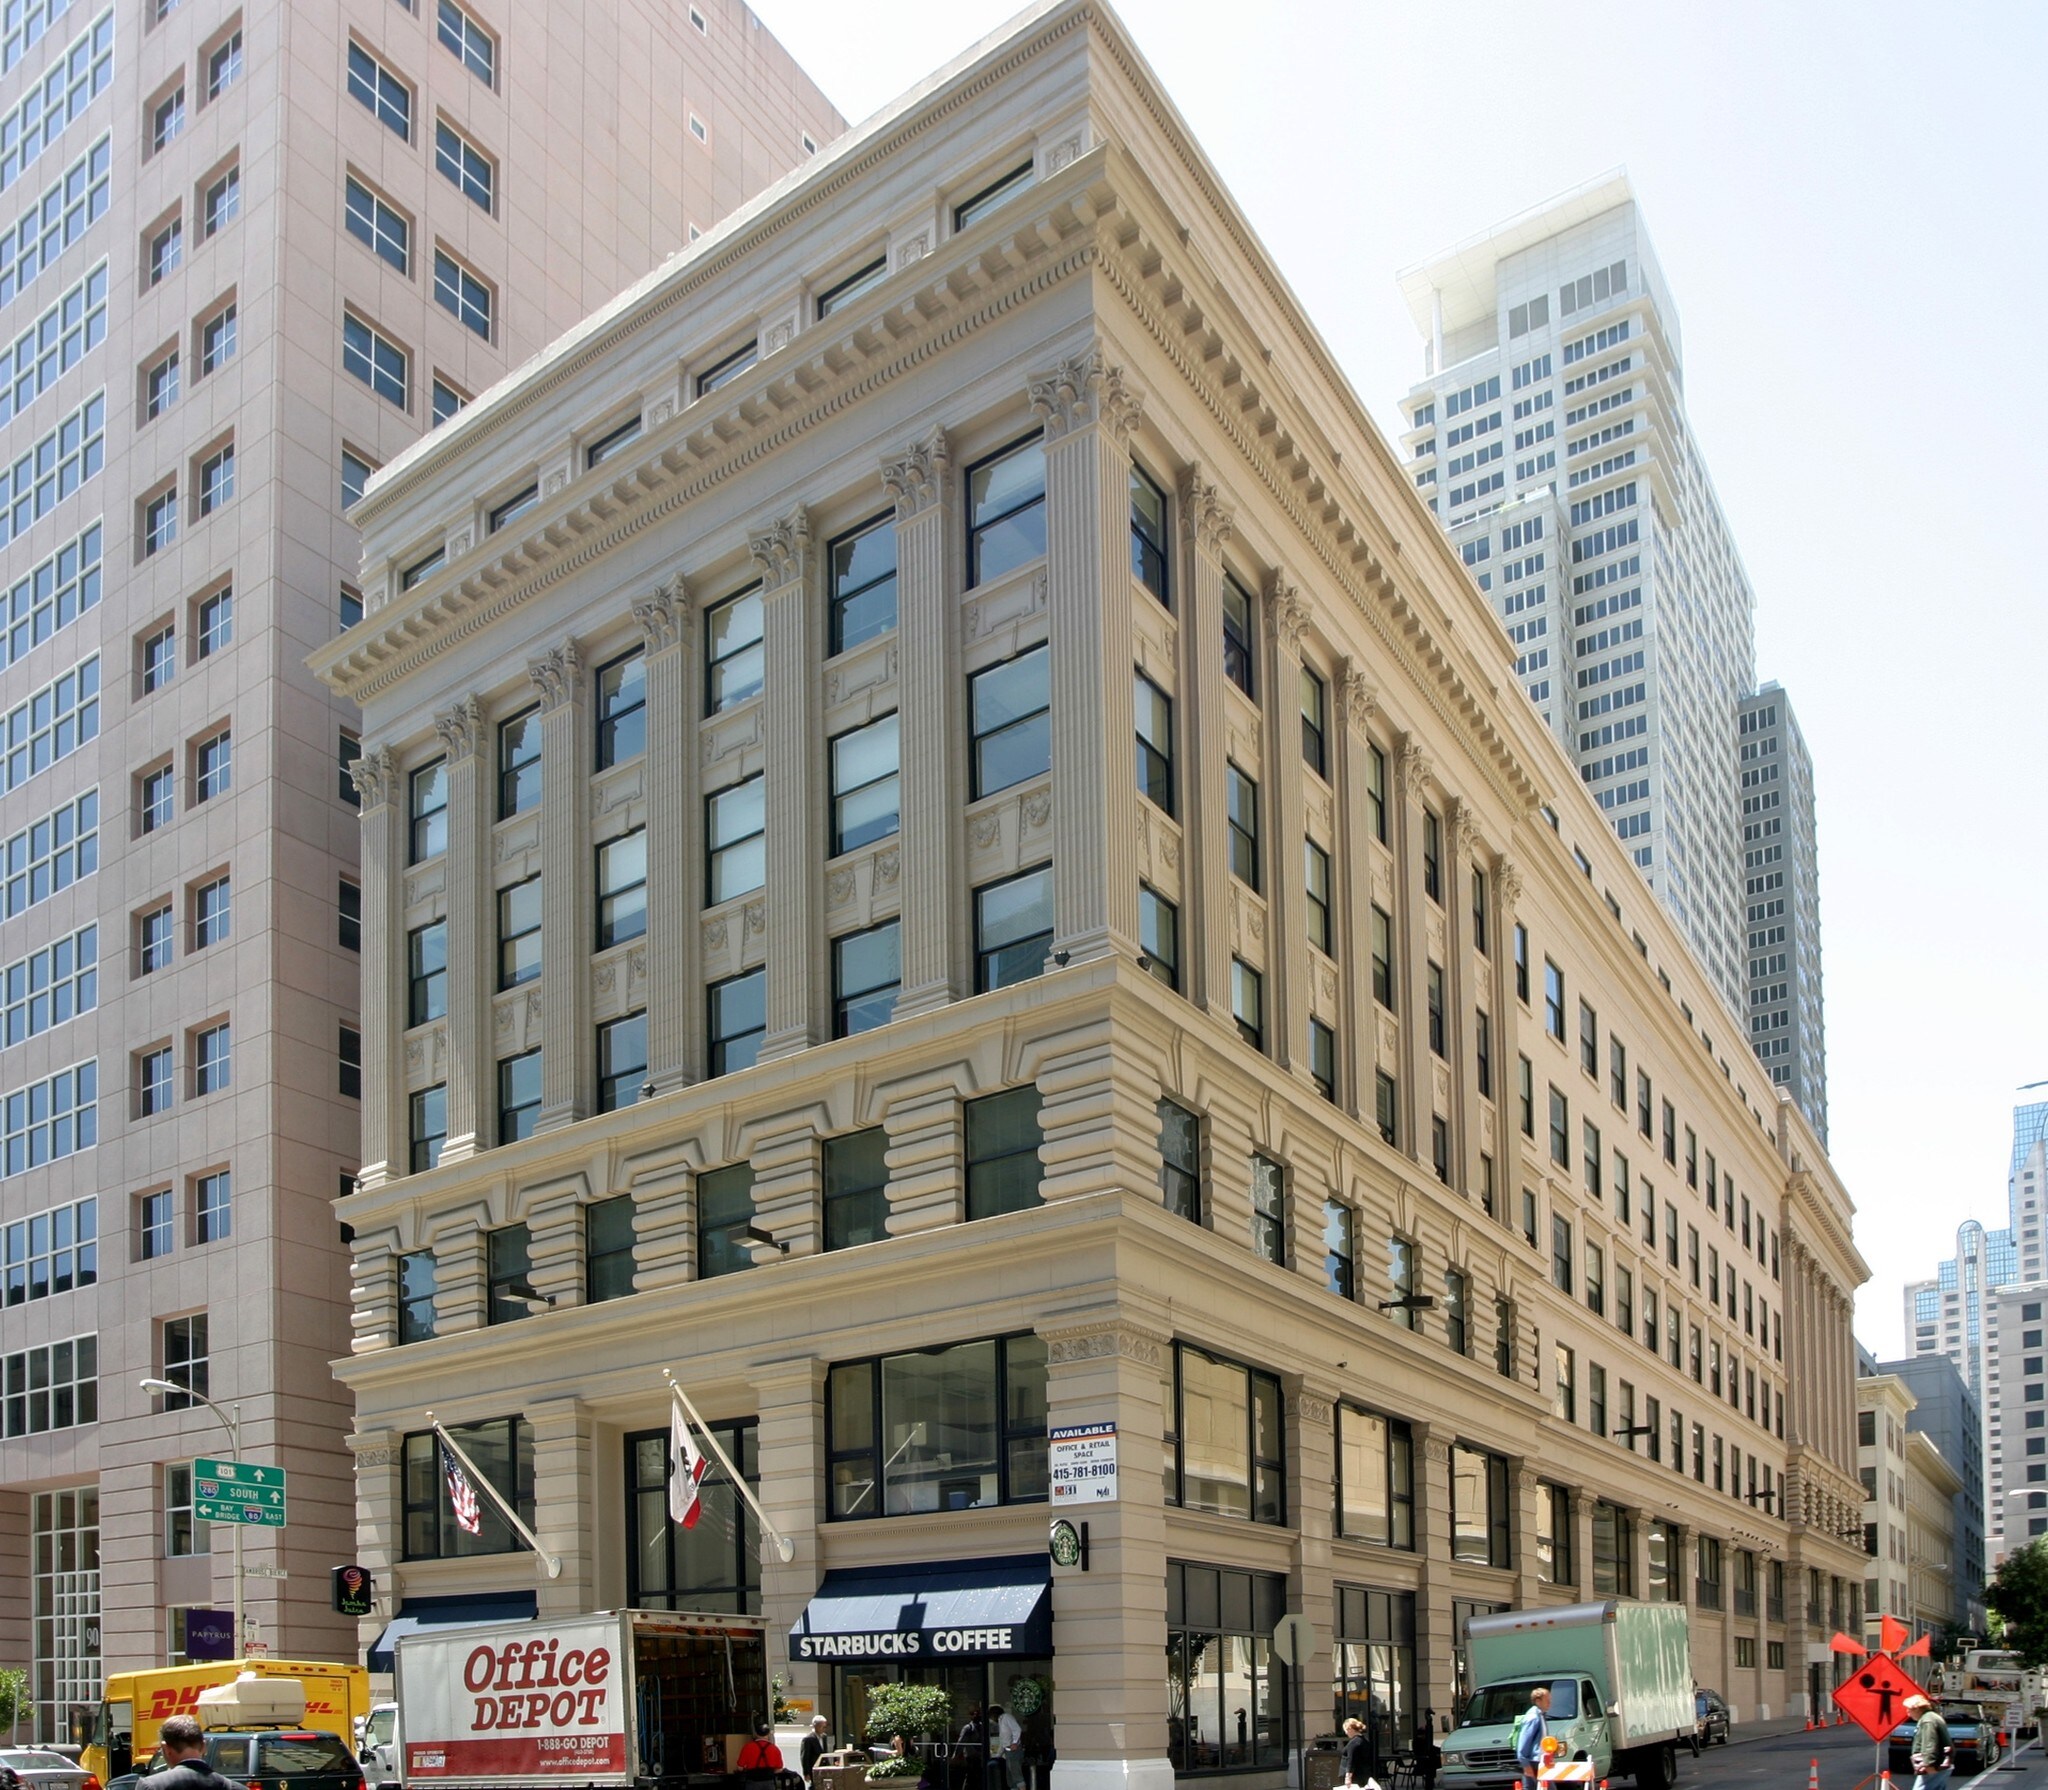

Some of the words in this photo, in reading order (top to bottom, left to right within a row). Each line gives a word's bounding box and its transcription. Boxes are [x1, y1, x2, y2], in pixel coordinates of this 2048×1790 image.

[1052, 1424, 1113, 1439] AVAILABLE
[1056, 1444, 1078, 1453] OFFICE
[1089, 1440, 1110, 1449] RETAIL
[1073, 1450, 1093, 1459] SPACE
[220, 1467, 232, 1476] 101
[1053, 1463, 1115, 1480] 415-781-8100
[202, 1486, 217, 1495] 280
[229, 1487, 259, 1500] SOUTH
[220, 1504, 234, 1512] BAY
[215, 1511, 240, 1521] BRIDGE
[248, 1512, 259, 1521] 80
[86, 1627, 99, 1647] 90
[192, 1630, 231, 1640] PAPYRUS
[800, 1631, 920, 1657] STARBUCKS
[932, 1628, 1012, 1652] COFFEE
[464, 1638, 611, 1693] Office
[150, 1683, 220, 1720] DH
[305, 1702, 333, 1714] HL
[471, 1688, 607, 1731] DEPOT
[537, 1737, 577, 1751] 1-888-GO
[580, 1736, 609, 1749] DEPOT
[540, 1756, 611, 1767] www.officedepot.com
